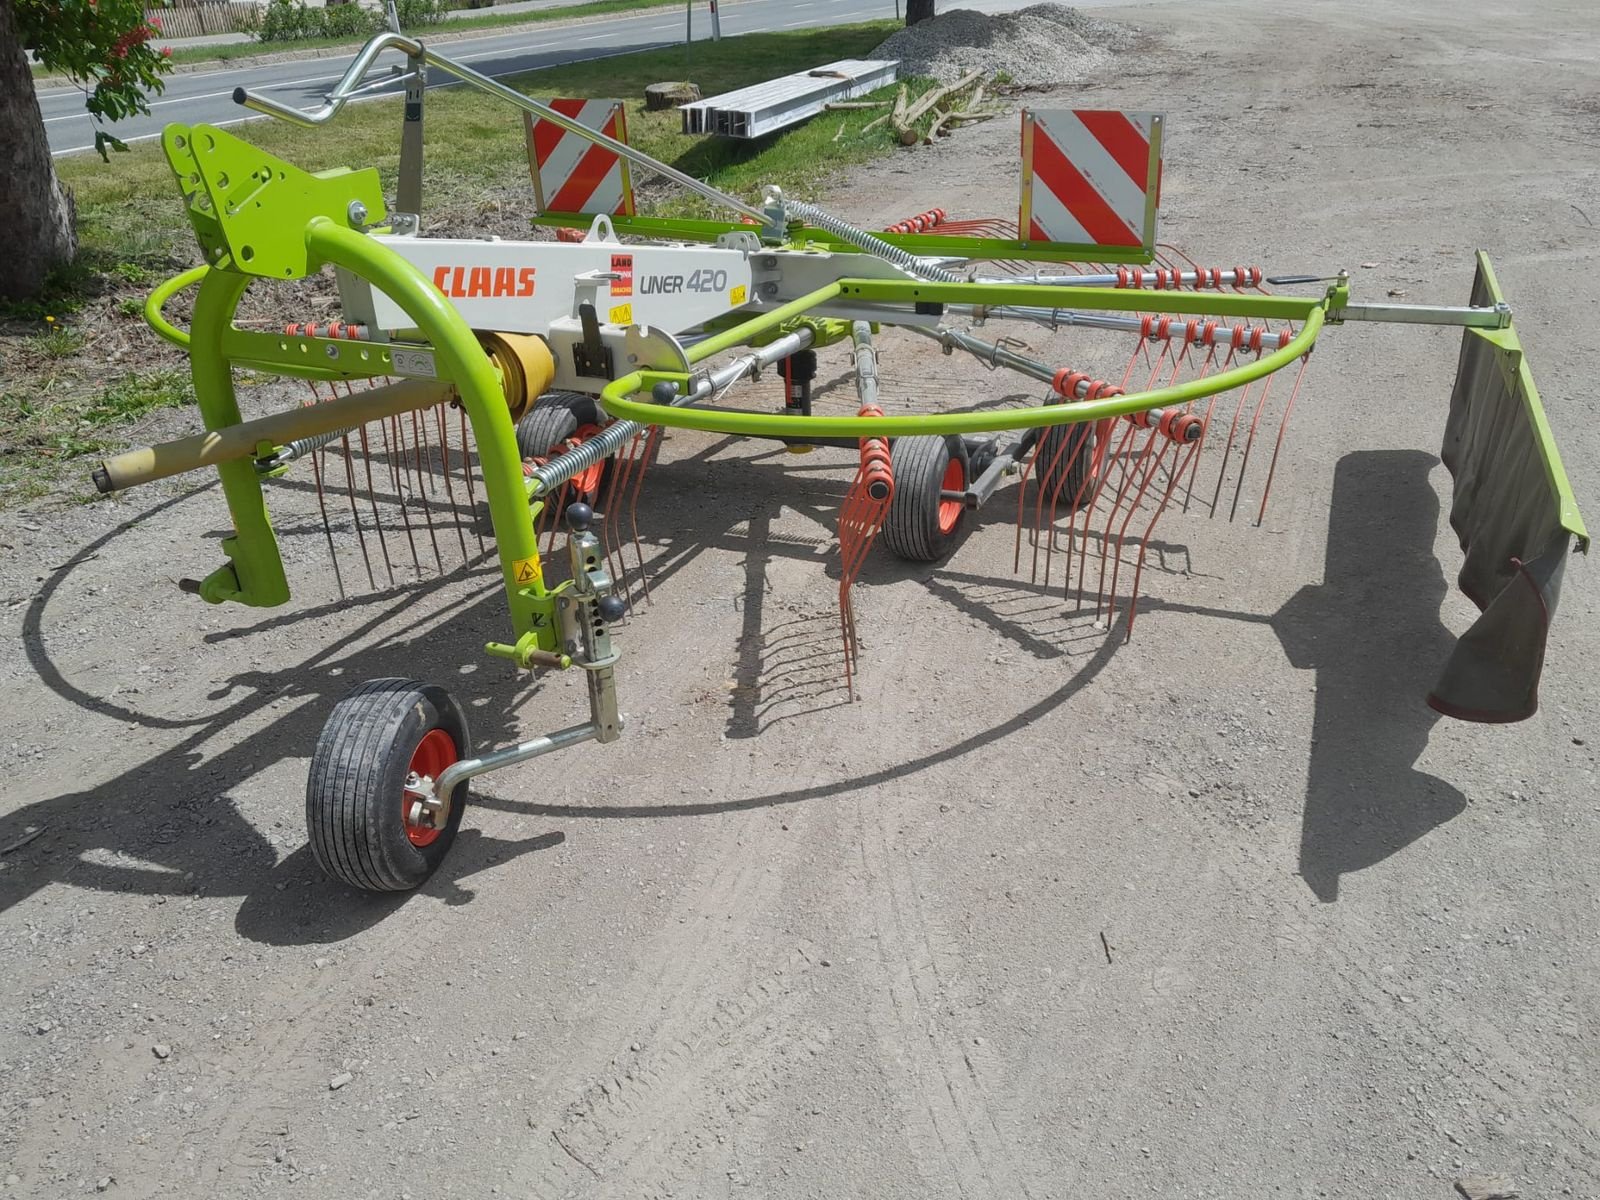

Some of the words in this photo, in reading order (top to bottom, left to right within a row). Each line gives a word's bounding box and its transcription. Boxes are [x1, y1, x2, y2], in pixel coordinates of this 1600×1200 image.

[433, 266, 536, 298] CLAAS
[640, 275, 684, 295] LINER
[686, 269, 727, 293] 420
